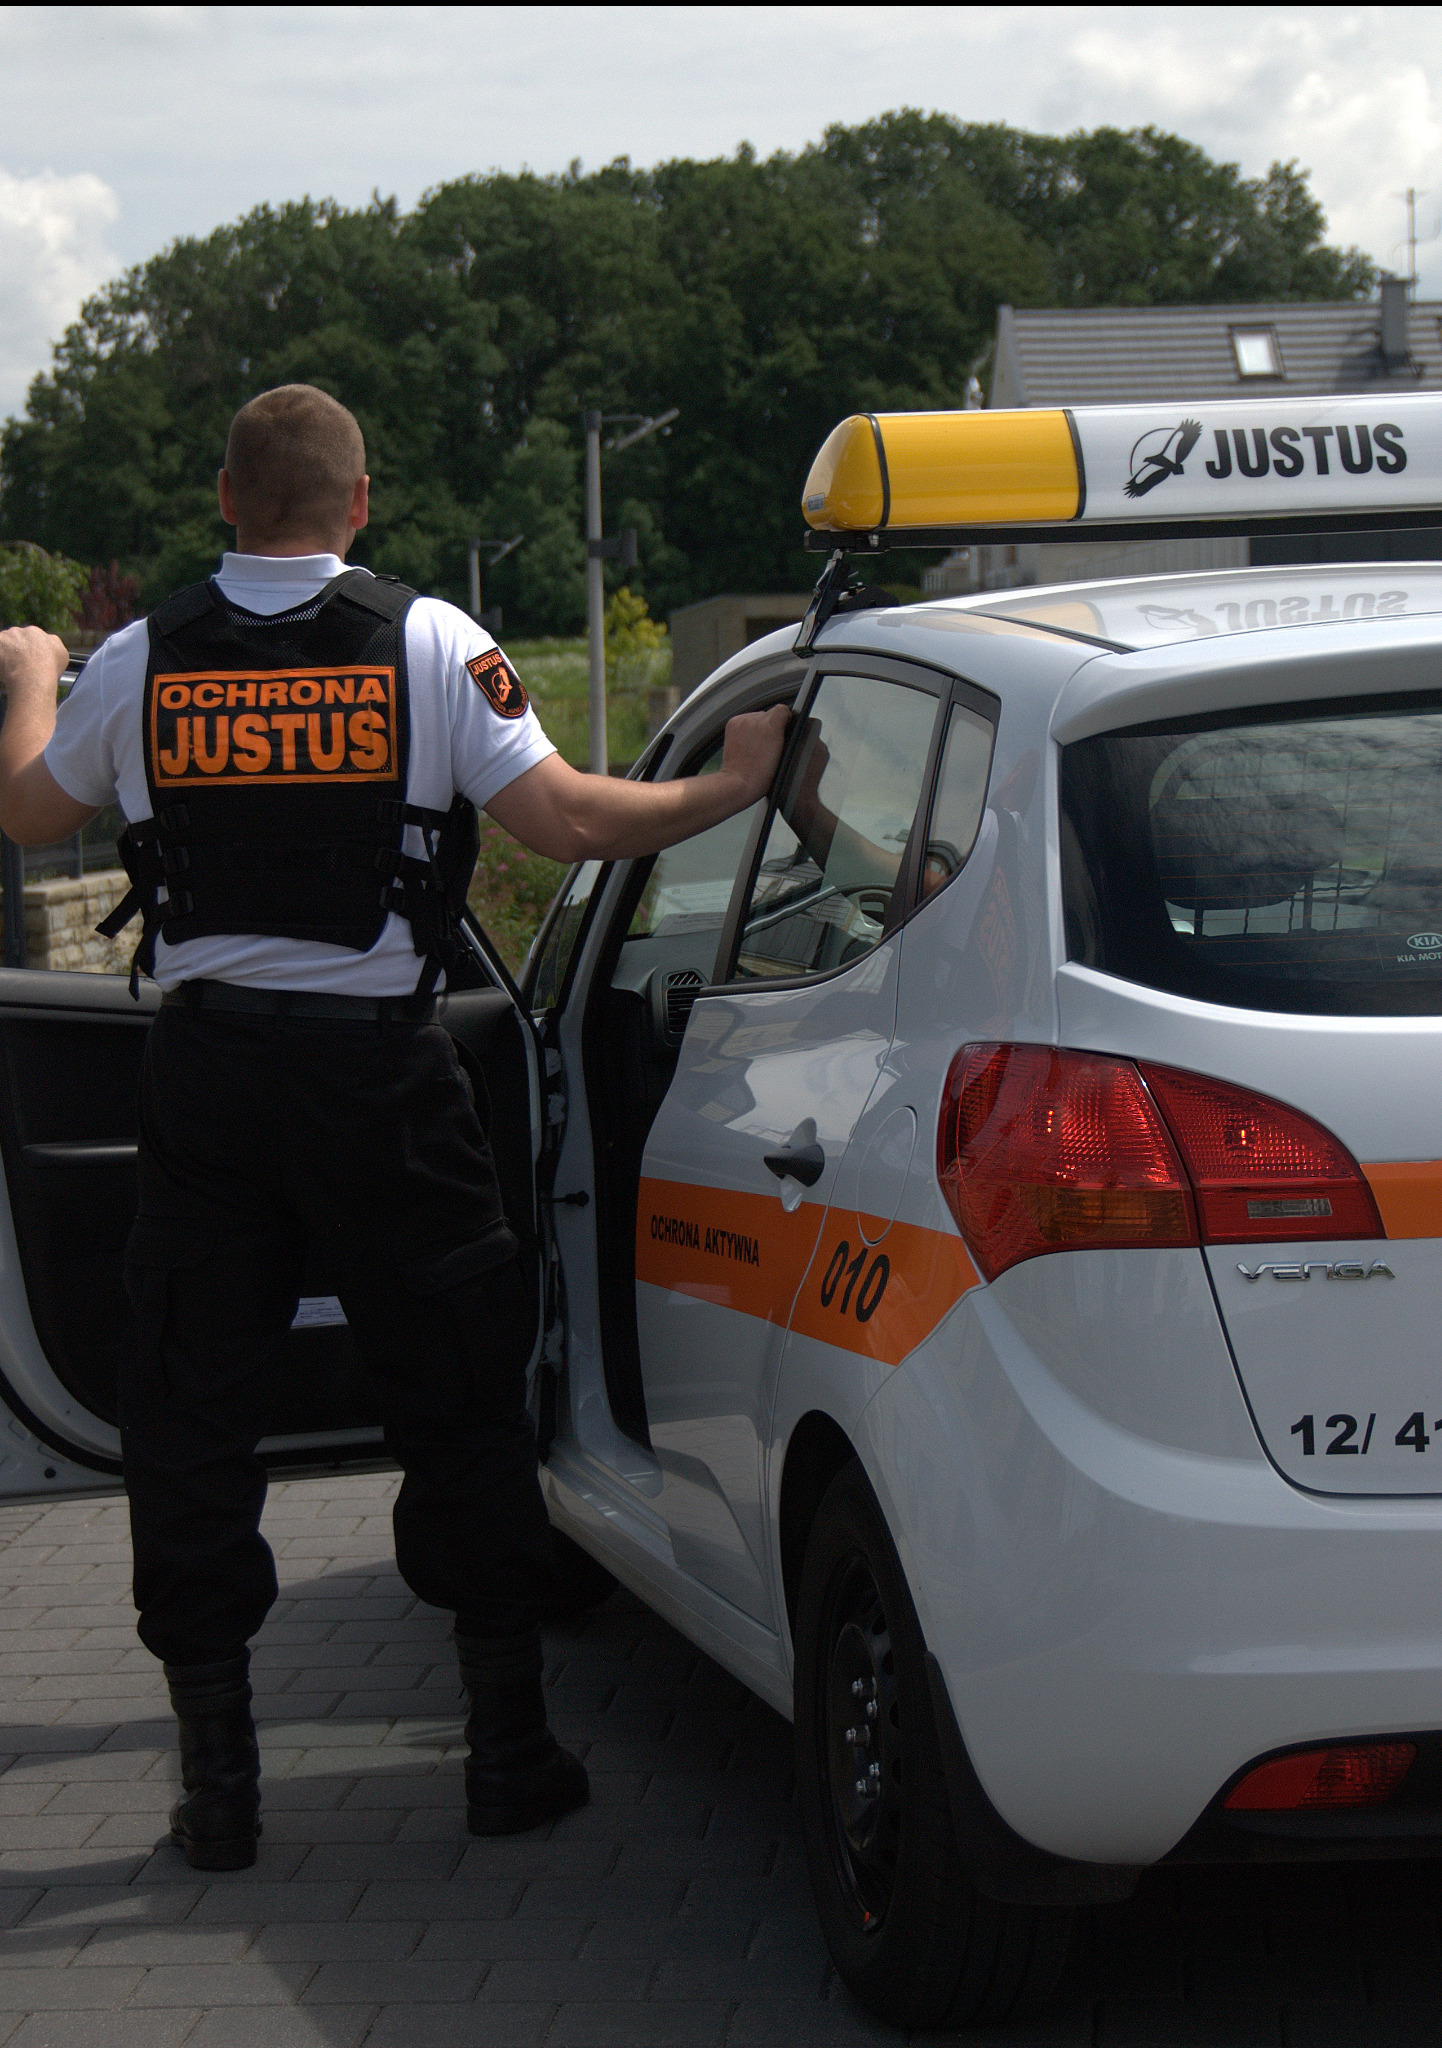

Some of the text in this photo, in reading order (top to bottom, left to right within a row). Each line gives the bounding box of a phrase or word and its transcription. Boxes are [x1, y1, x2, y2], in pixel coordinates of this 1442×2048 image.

[1205, 423, 1408, 479] JUSTUS
[473, 653, 503, 675] JUSTUS
[160, 678, 388, 710] OCHRONA
[159, 710, 389, 776] JUSTUS
[1397, 954, 1416, 963] KIA
[1413, 936, 1441, 946] KIA
[651, 1214, 760, 1267] OCHRONA AKTYWNA
[820, 1240, 890, 1323] 010
[1236, 1258, 1396, 1283] VENGA
[1290, 1413, 1377, 1456] 12/
